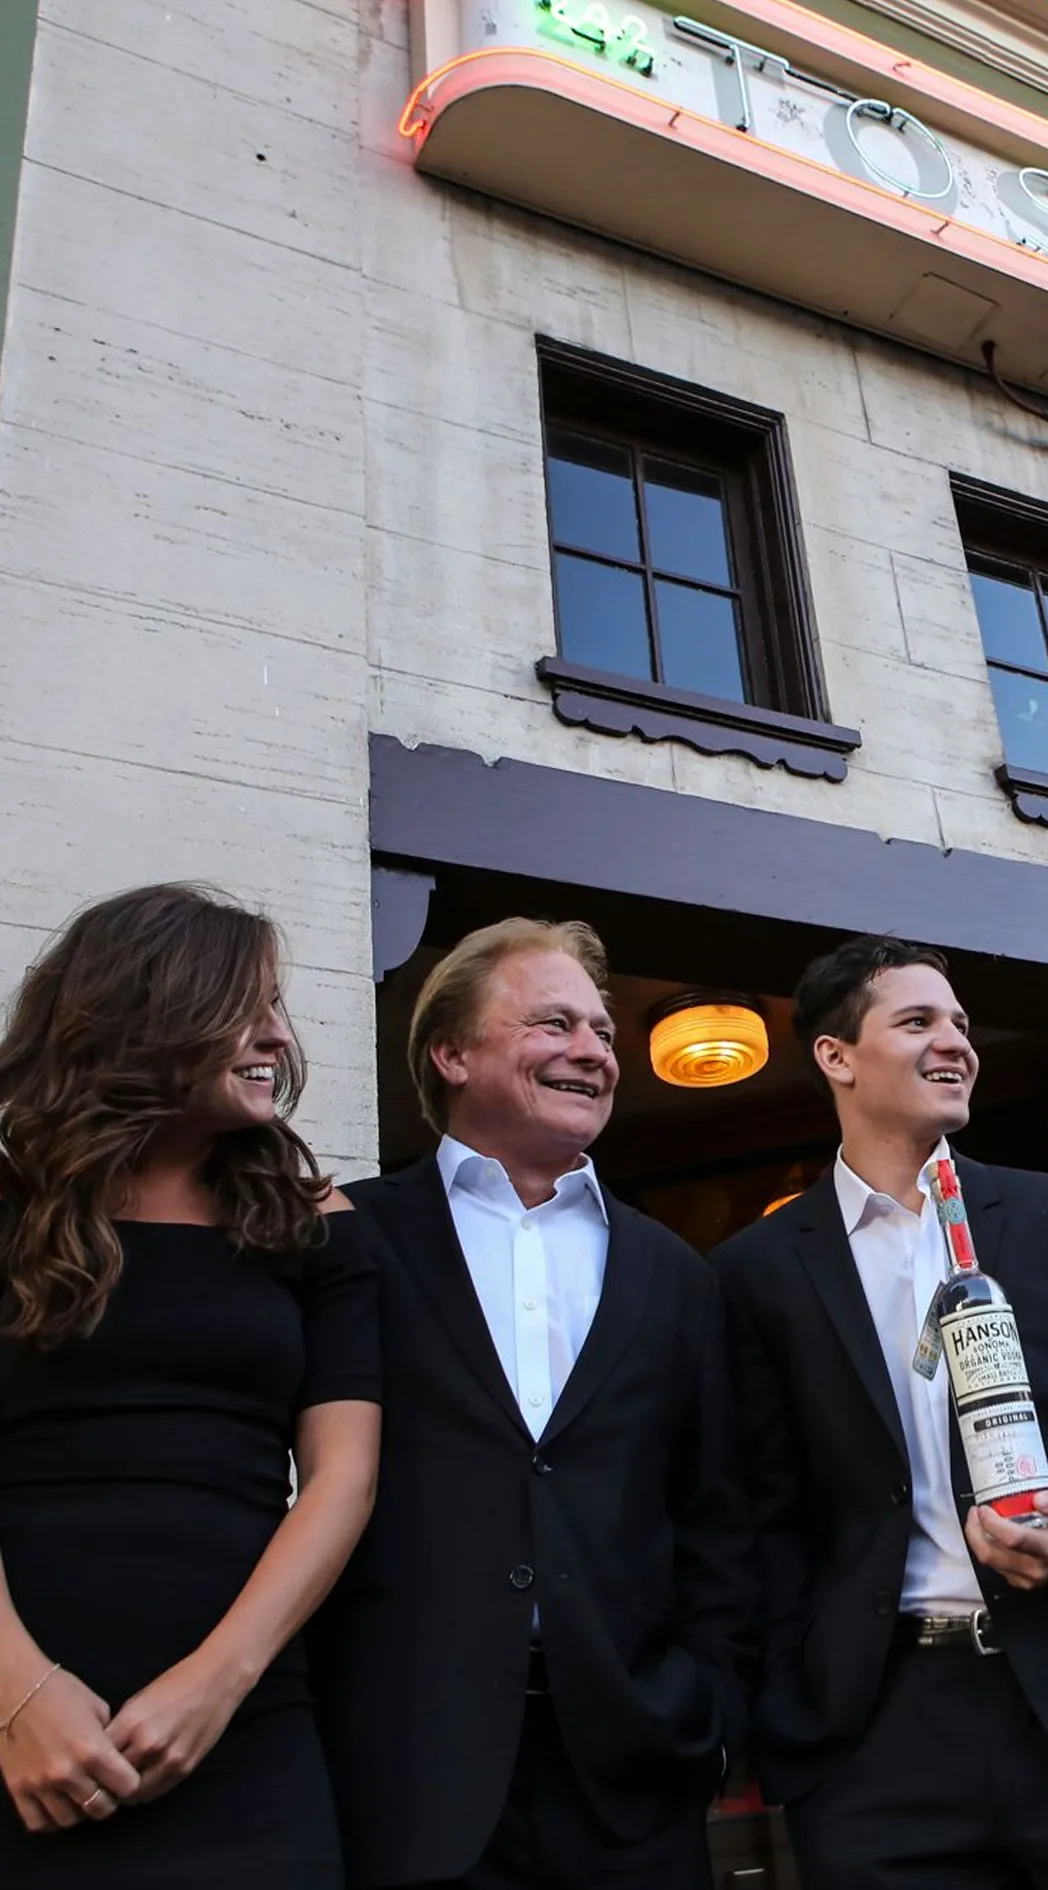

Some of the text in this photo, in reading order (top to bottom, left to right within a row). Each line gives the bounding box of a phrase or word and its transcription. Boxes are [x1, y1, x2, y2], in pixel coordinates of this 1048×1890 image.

[951, 1320, 1019, 1356] HANSON
[973, 1340, 1010, 1353] SONOMA
[959, 1353, 1000, 1371] ORGANIC
[985, 1413, 1029, 1427] ORIGINAL
